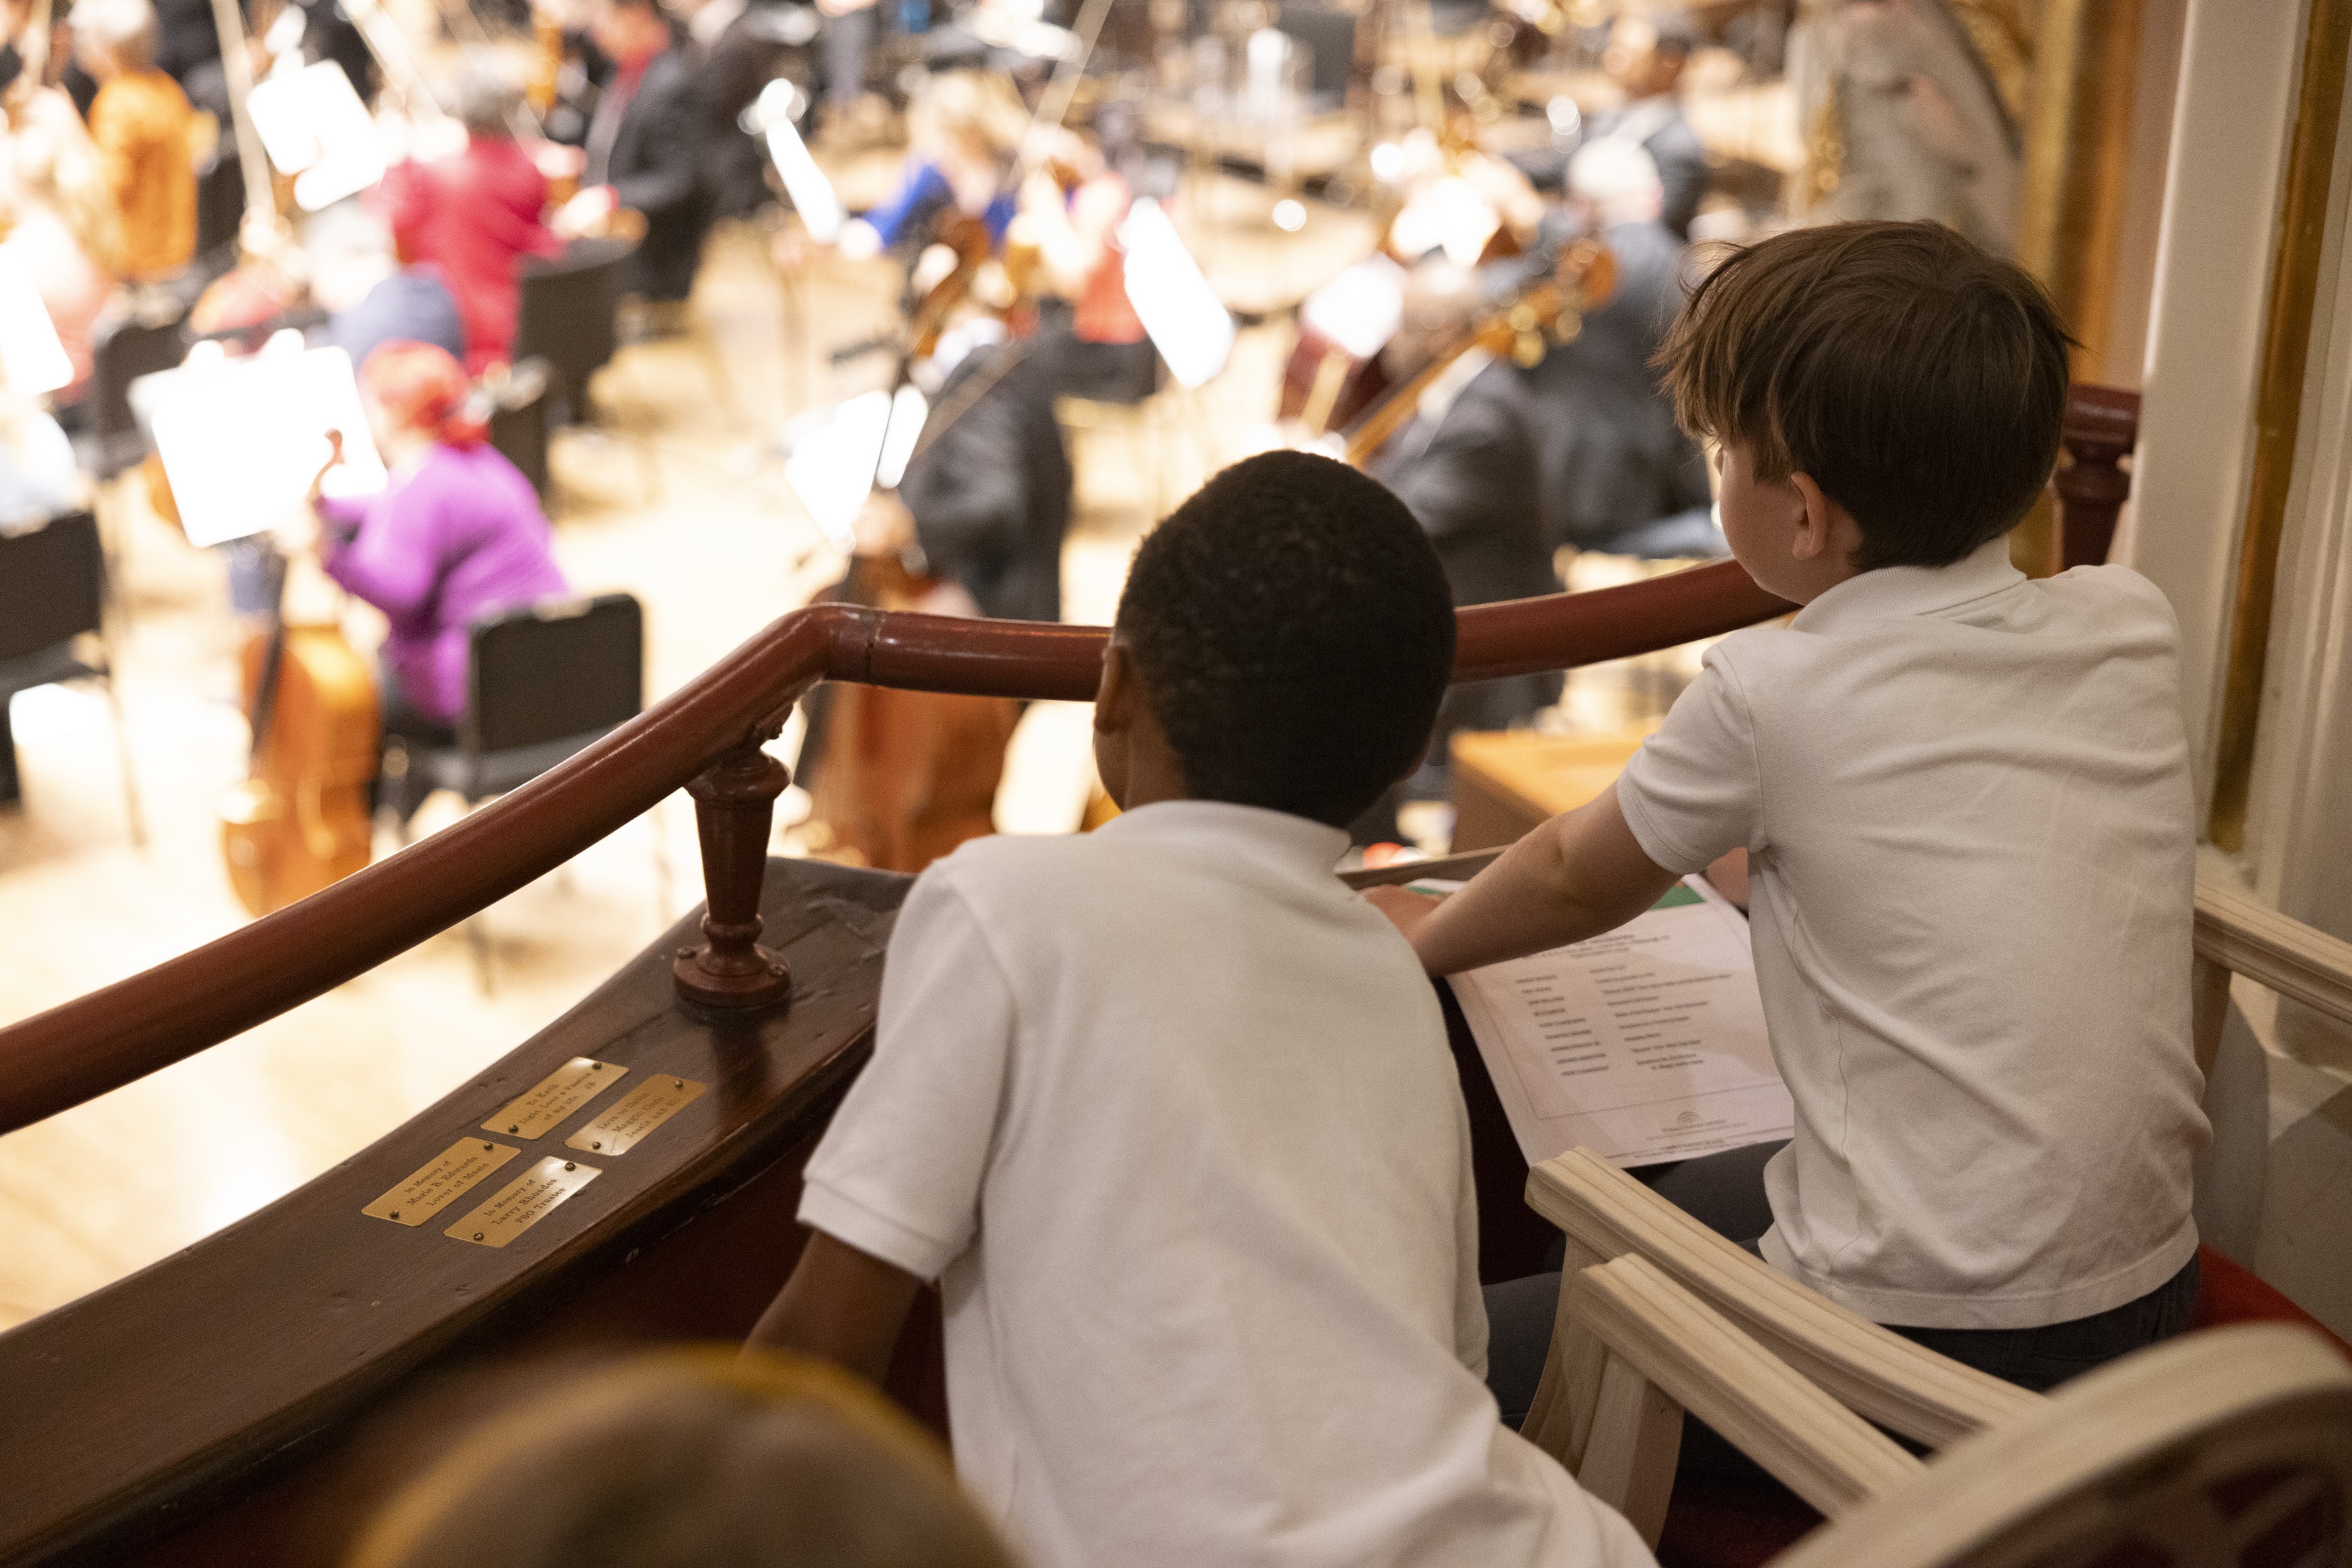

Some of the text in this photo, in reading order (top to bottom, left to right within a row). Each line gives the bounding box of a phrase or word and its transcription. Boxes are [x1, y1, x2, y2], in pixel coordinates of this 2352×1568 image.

[407, 1188, 434, 1205] Marie
[442, 1156, 478, 1180] Edwards
[413, 1167, 442, 1186] Memory
[427, 1188, 454, 1205] Lover
[464, 1162, 490, 1179] Music
[492, 1178, 558, 1224] Larry Rhoades
[495, 1186, 526, 1208] Memory
[515, 1188, 566, 1223] PSO Trustee
